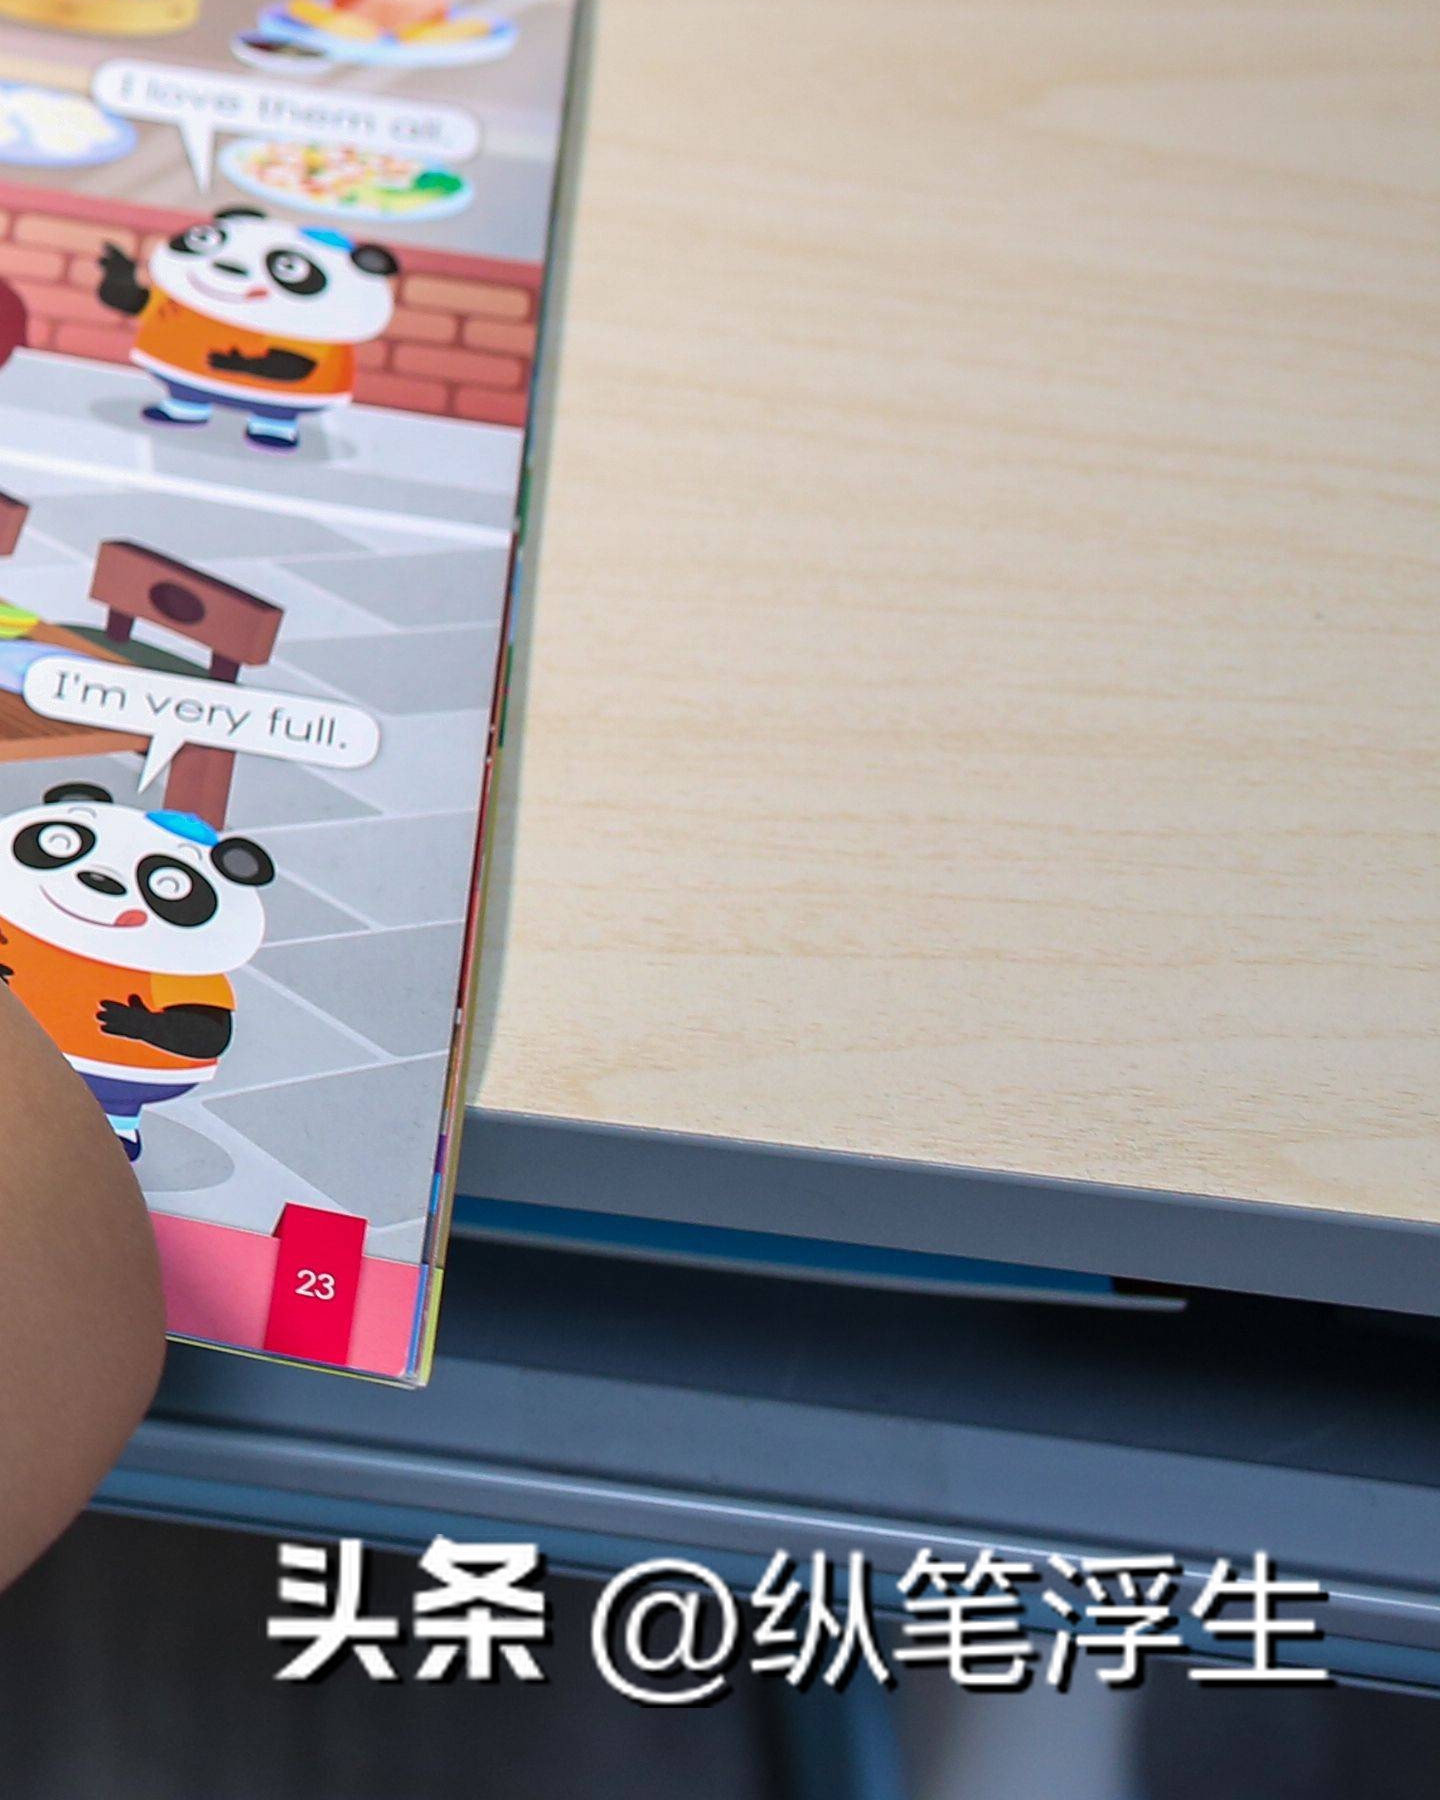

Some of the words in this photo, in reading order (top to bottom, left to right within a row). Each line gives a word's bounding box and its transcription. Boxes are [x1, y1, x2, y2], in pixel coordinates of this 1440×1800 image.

[147, 75, 243, 115] love
[257, 97, 377, 134] them
[52, 669, 127, 711] I'm
[145, 693, 252, 737] very
[268, 706, 348, 750] full.
[294, 1268, 336, 1301] 23
